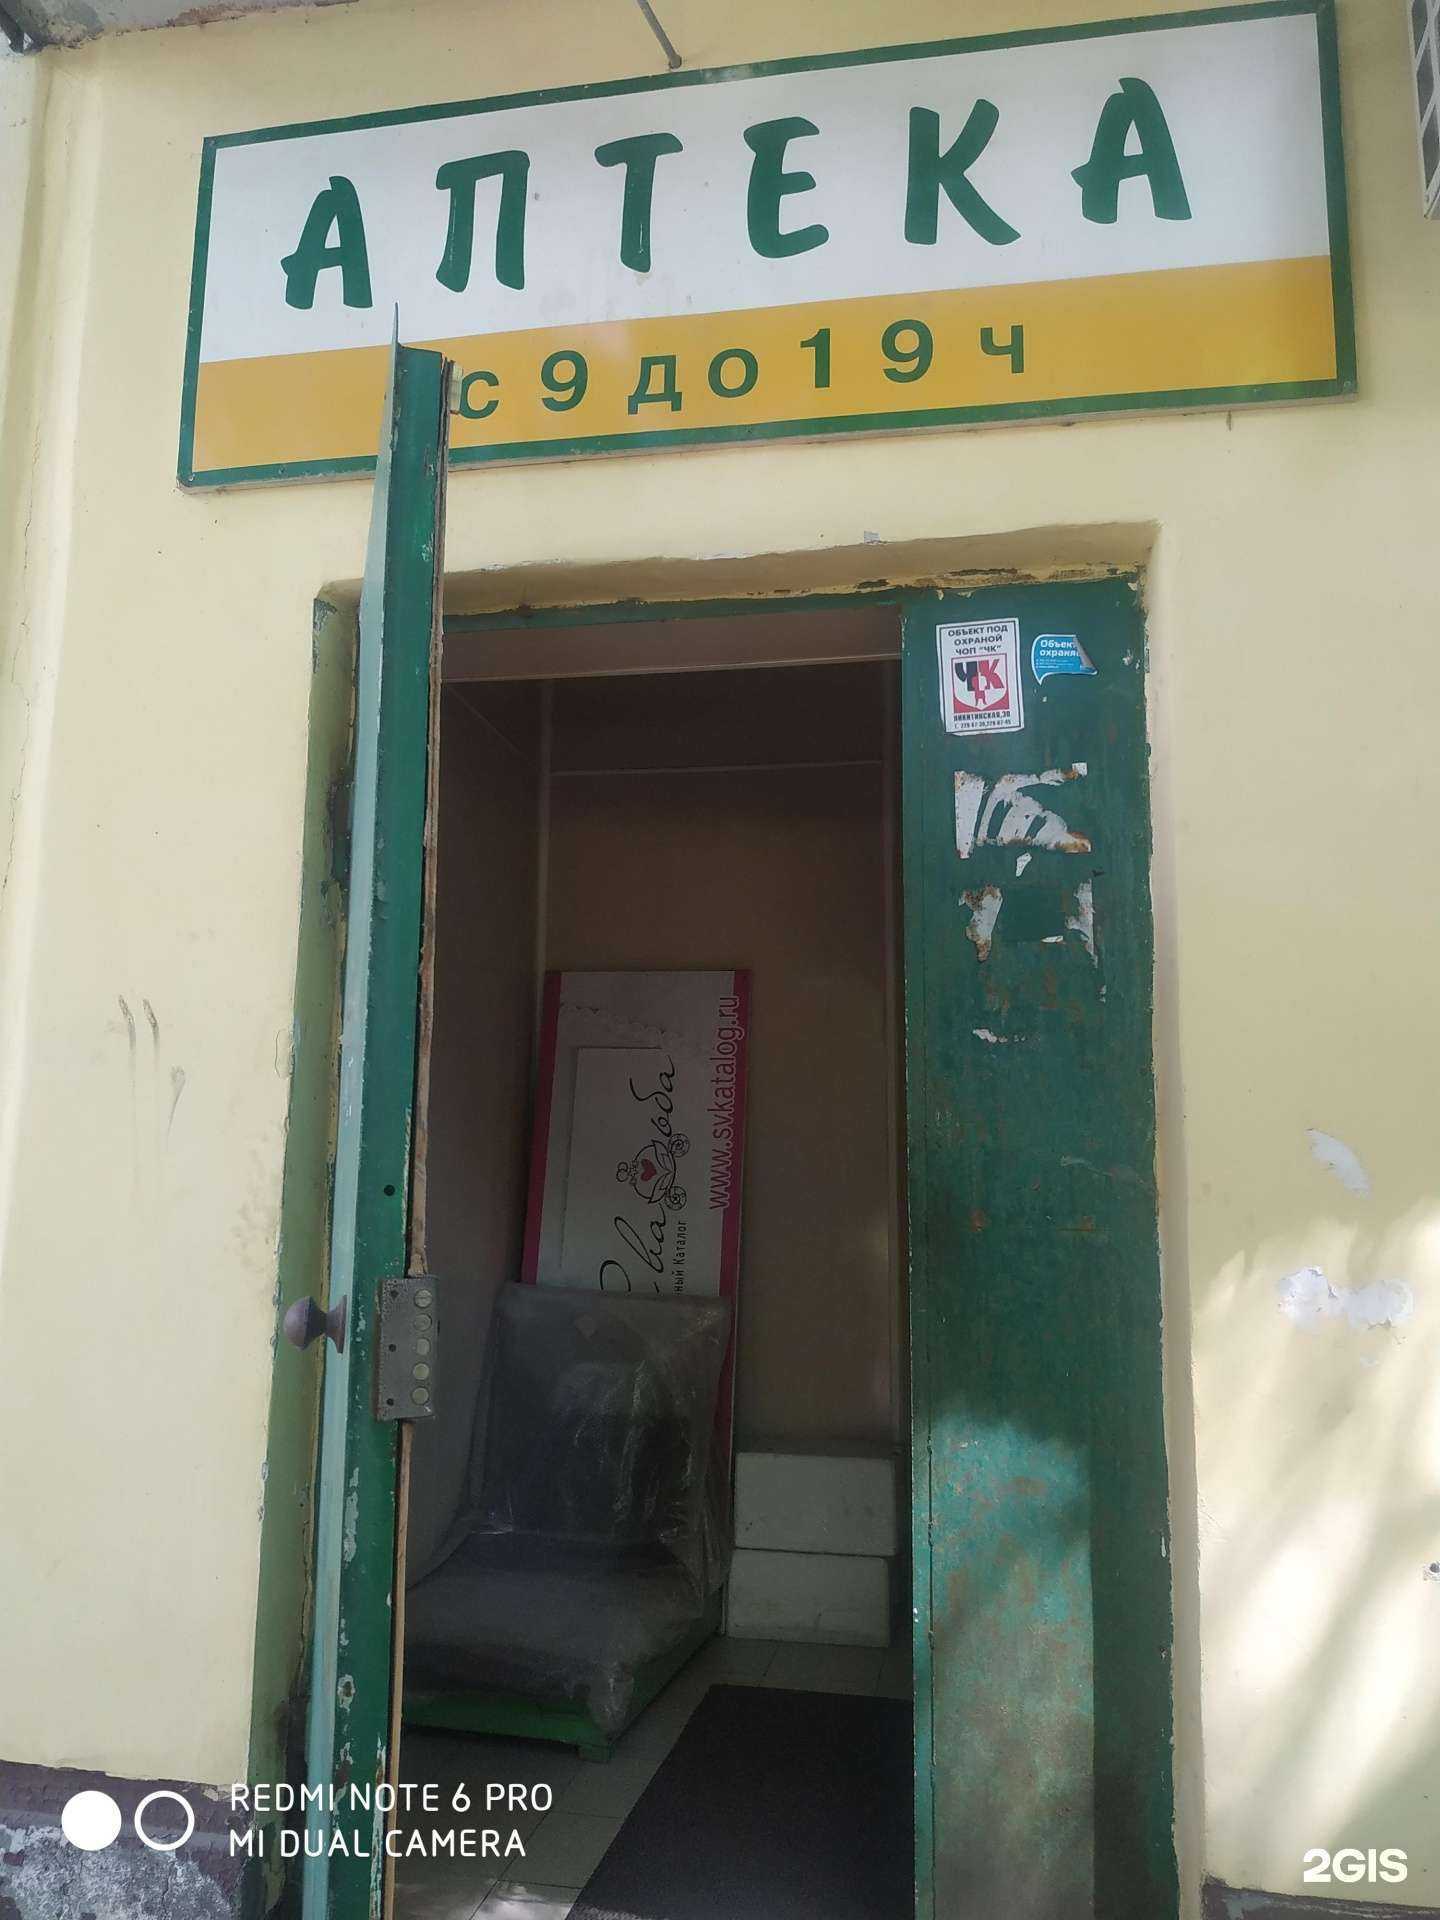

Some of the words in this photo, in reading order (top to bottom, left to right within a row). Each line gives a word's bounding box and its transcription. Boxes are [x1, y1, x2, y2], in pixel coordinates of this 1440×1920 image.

[280, 77, 1192, 310] АПТЕКА
[540, 350, 589, 413] 9
[627, 348, 760, 416] до
[800, 319, 934, 389] 19
[979, 324, 1025, 375] ч
[948, 627, 984, 637] ОБЪЕКТ
[986, 625, 1008, 634] ПОД
[954, 633, 1003, 646] ОХРАНОЙ
[955, 647, 976, 655] ЧОП
[707, 995, 745, 1210] www.svkatalog.ru
[672, 1220, 689, 1265] Каталог
[672, 1267, 686, 1296] ный
